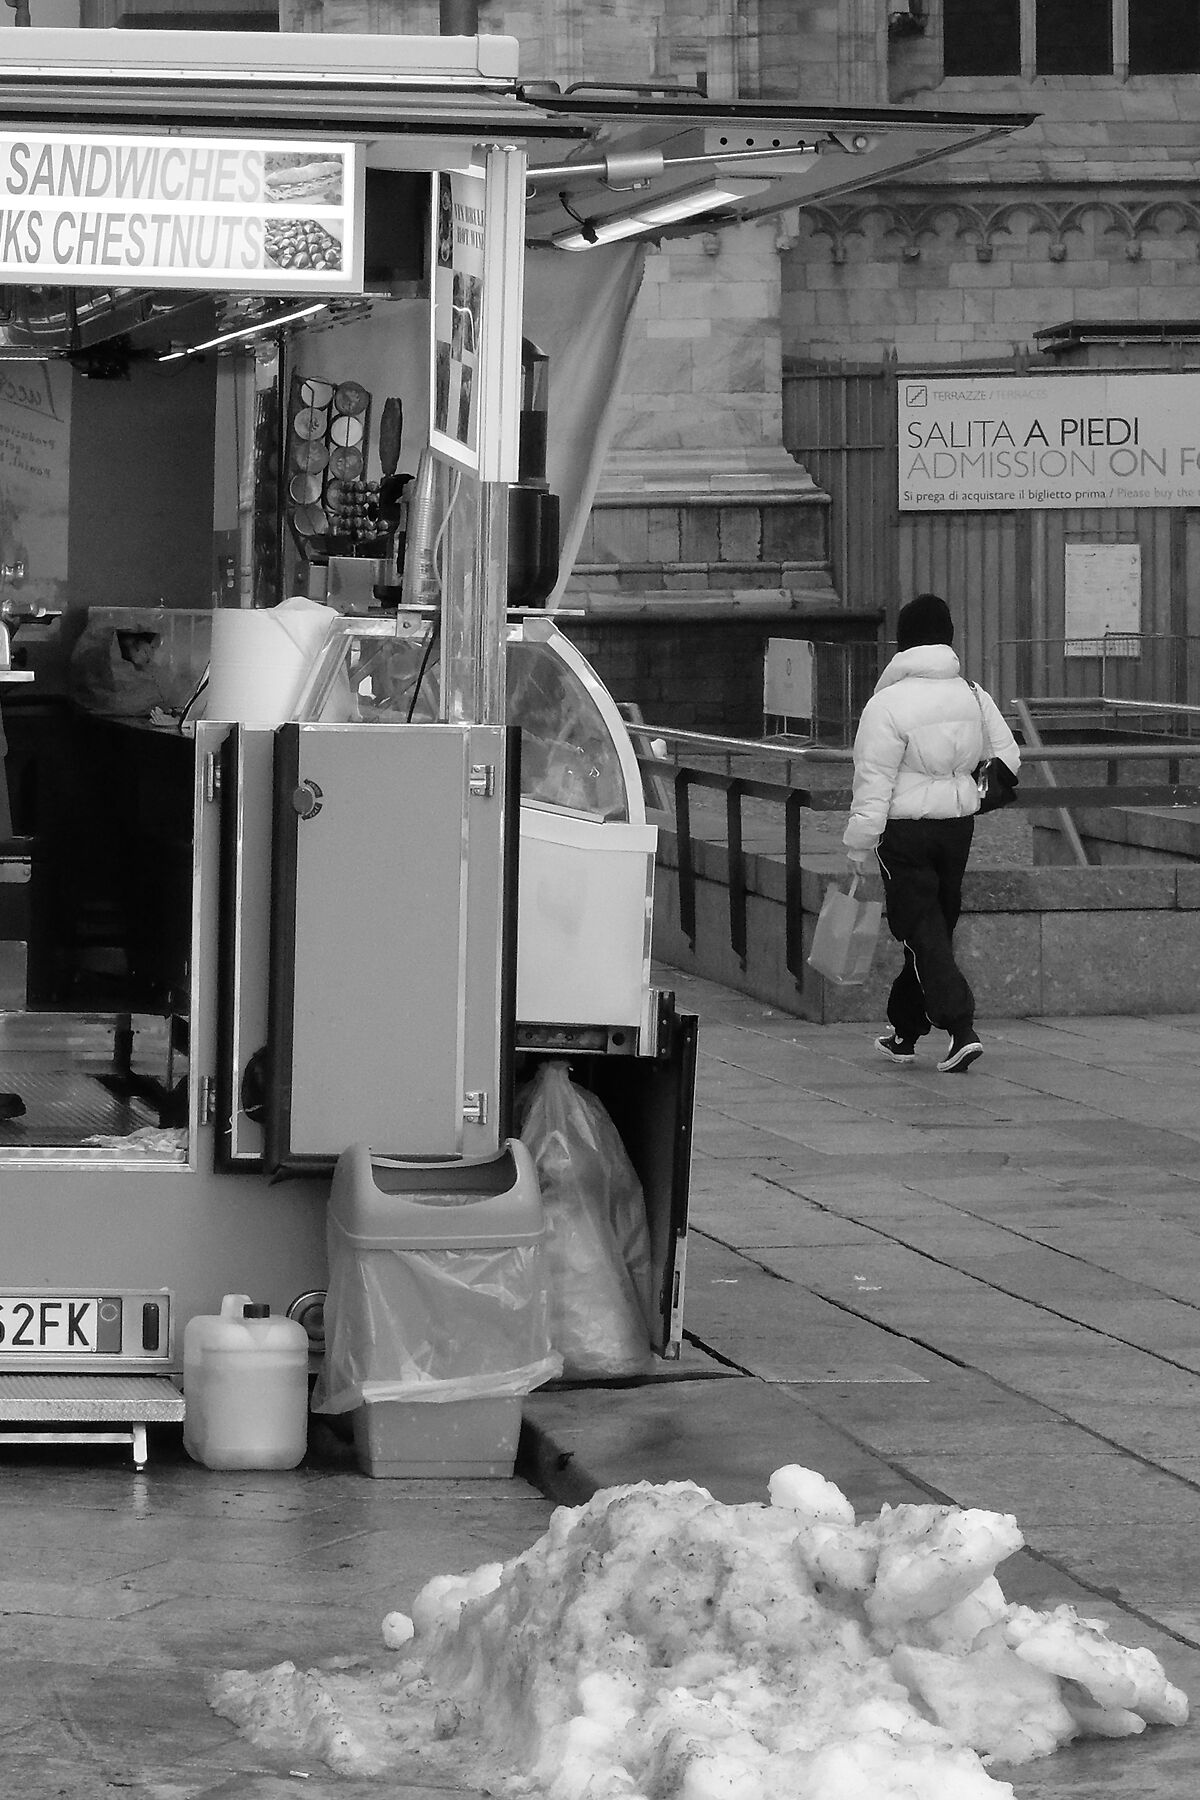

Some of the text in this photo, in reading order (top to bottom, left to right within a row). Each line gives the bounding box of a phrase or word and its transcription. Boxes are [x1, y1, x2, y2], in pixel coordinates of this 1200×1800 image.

[6, 142, 263, 203] SANDWICHES
[53, 211, 263, 269] CHESTNUTS
[932, 390, 987, 401] TERRAZZE
[907, 417, 1139, 448] SALITA A PIEDI
[907, 447, 1200, 479] ADMISSION ON F
[904, 490, 913, 501] Si
[916, 491, 945, 503] prega
[949, 490, 958, 500] di
[961, 490, 1015, 503] acquistare
[1019, 489, 1025, 500] il
[1028, 488, 1072, 502] biglietto
[1075, 490, 1106, 502] prima
[1117, 487, 1150, 499] Please
[1154, 487, 1173, 500] buy
[1177, 487, 1194, 498] the
